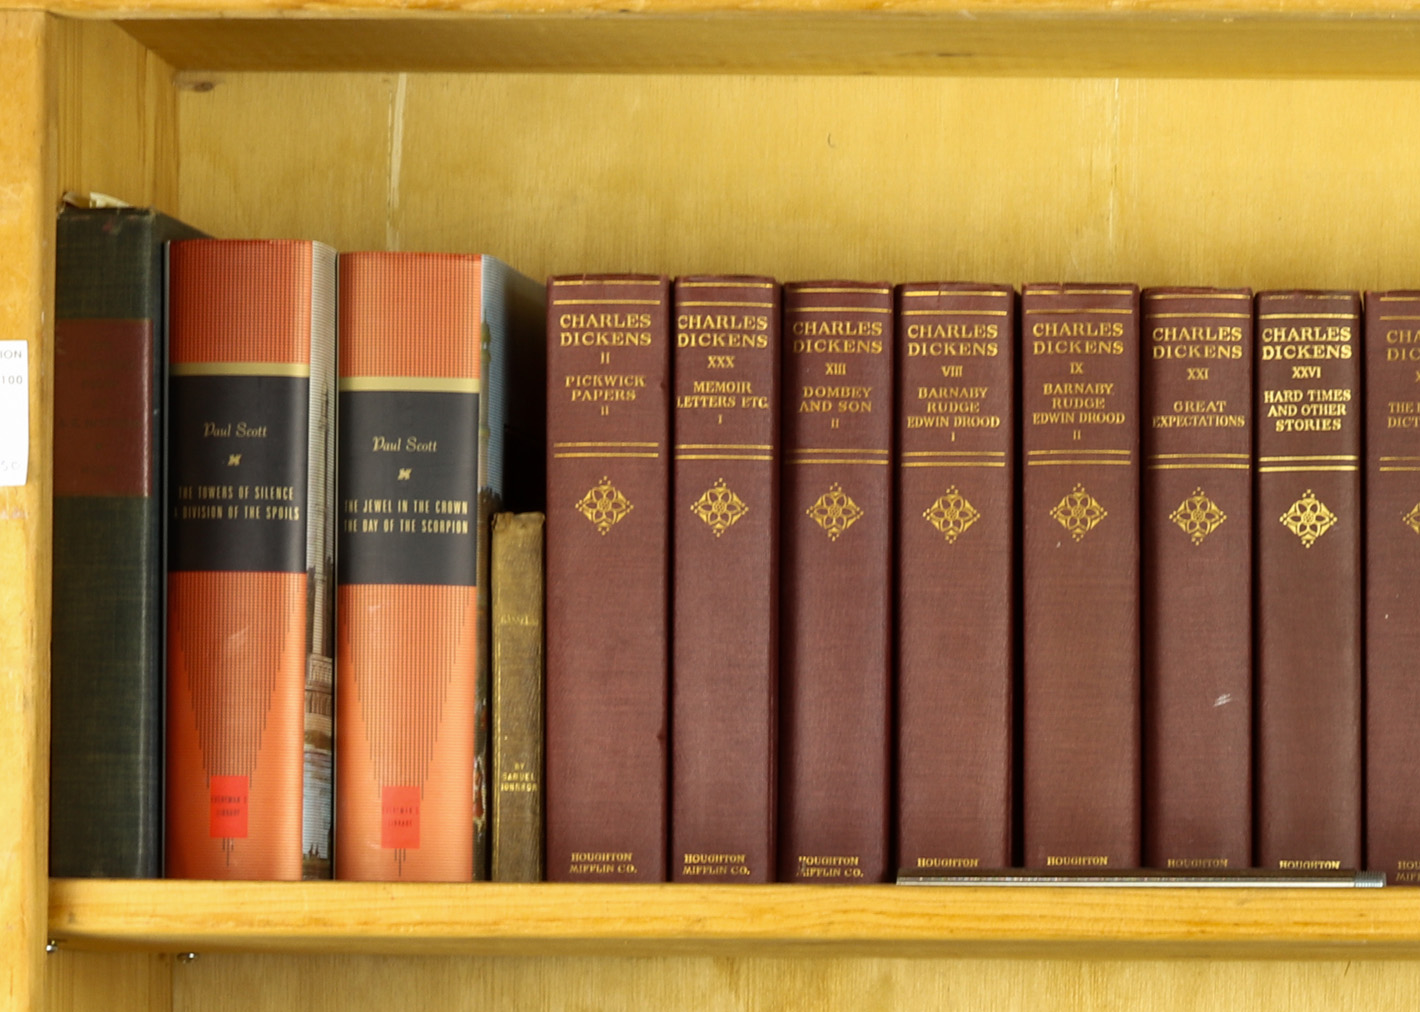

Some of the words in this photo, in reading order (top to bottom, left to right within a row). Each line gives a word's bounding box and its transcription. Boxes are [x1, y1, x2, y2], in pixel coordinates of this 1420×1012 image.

[560, 313, 651, 328] CHARLES
[907, 324, 998, 339] CHARLES
[1033, 322, 1124, 337] CHARLES
[1262, 327, 1352, 342] CHARLES
[560, 332, 652, 346] DICKENS
[908, 342, 998, 357] DICKENS
[1033, 340, 1124, 355] DICKENS
[1262, 345, 1352, 359] DICKENS
[707, 355, 735, 368] XXX
[941, 365, 963, 377] VIII
[1292, 366, 1321, 379] XXVI
[565, 375, 646, 387] PICKWICK
[693, 381, 752, 394] MEMOIR
[571, 389, 636, 401] PAPERS
[803, 386, 872, 398] DOMBEY
[918, 387, 988, 399] BARNABY
[1264, 388, 1303, 403] HARD
[1307, 388, 1351, 403] TIMES
[677, 395, 736, 408] LETTERS
[798, 400, 832, 412] AND
[838, 401, 872, 412] SON
[927, 402, 979, 413] RUDGE
[1173, 400, 1226, 413] GREAT
[1388, 402, 1413, 414] THE
[1267, 403, 1297, 417] AND
[1301, 403, 1347, 417] OTHER
[907, 416, 949, 429] EDWIN
[953, 416, 1000, 429] DROOD
[1153, 415, 1245, 428] EXPECTATIONS
[1275, 418, 1342, 432] STORIES
[203, 421, 231, 438] Paul
[236, 421, 268, 438] Scott
[372, 435, 401, 452] Paul
[405, 436, 438, 452] Scott
[198, 485, 233, 500] TOWERS
[238, 486, 250, 500] OF
[254, 486, 295, 501] SILENCE
[182, 506, 223, 520] DIVISION
[228, 506, 239, 520] OF
[244, 506, 261, 520] THE
[265, 506, 300, 521] SPOILS
[363, 499, 392, 514] JEWEL
[397, 499, 408, 514] IN
[413, 500, 430, 514] THE
[435, 500, 469, 515] CROWN
[362, 518, 378, 532] DAY
[383, 519, 394, 532] OF
[400, 519, 416, 533] THE
[421, 519, 469, 534] SCORPION
[684, 853, 746, 865] HOUGHTON
[682, 866, 727, 876] MIFFLIN
